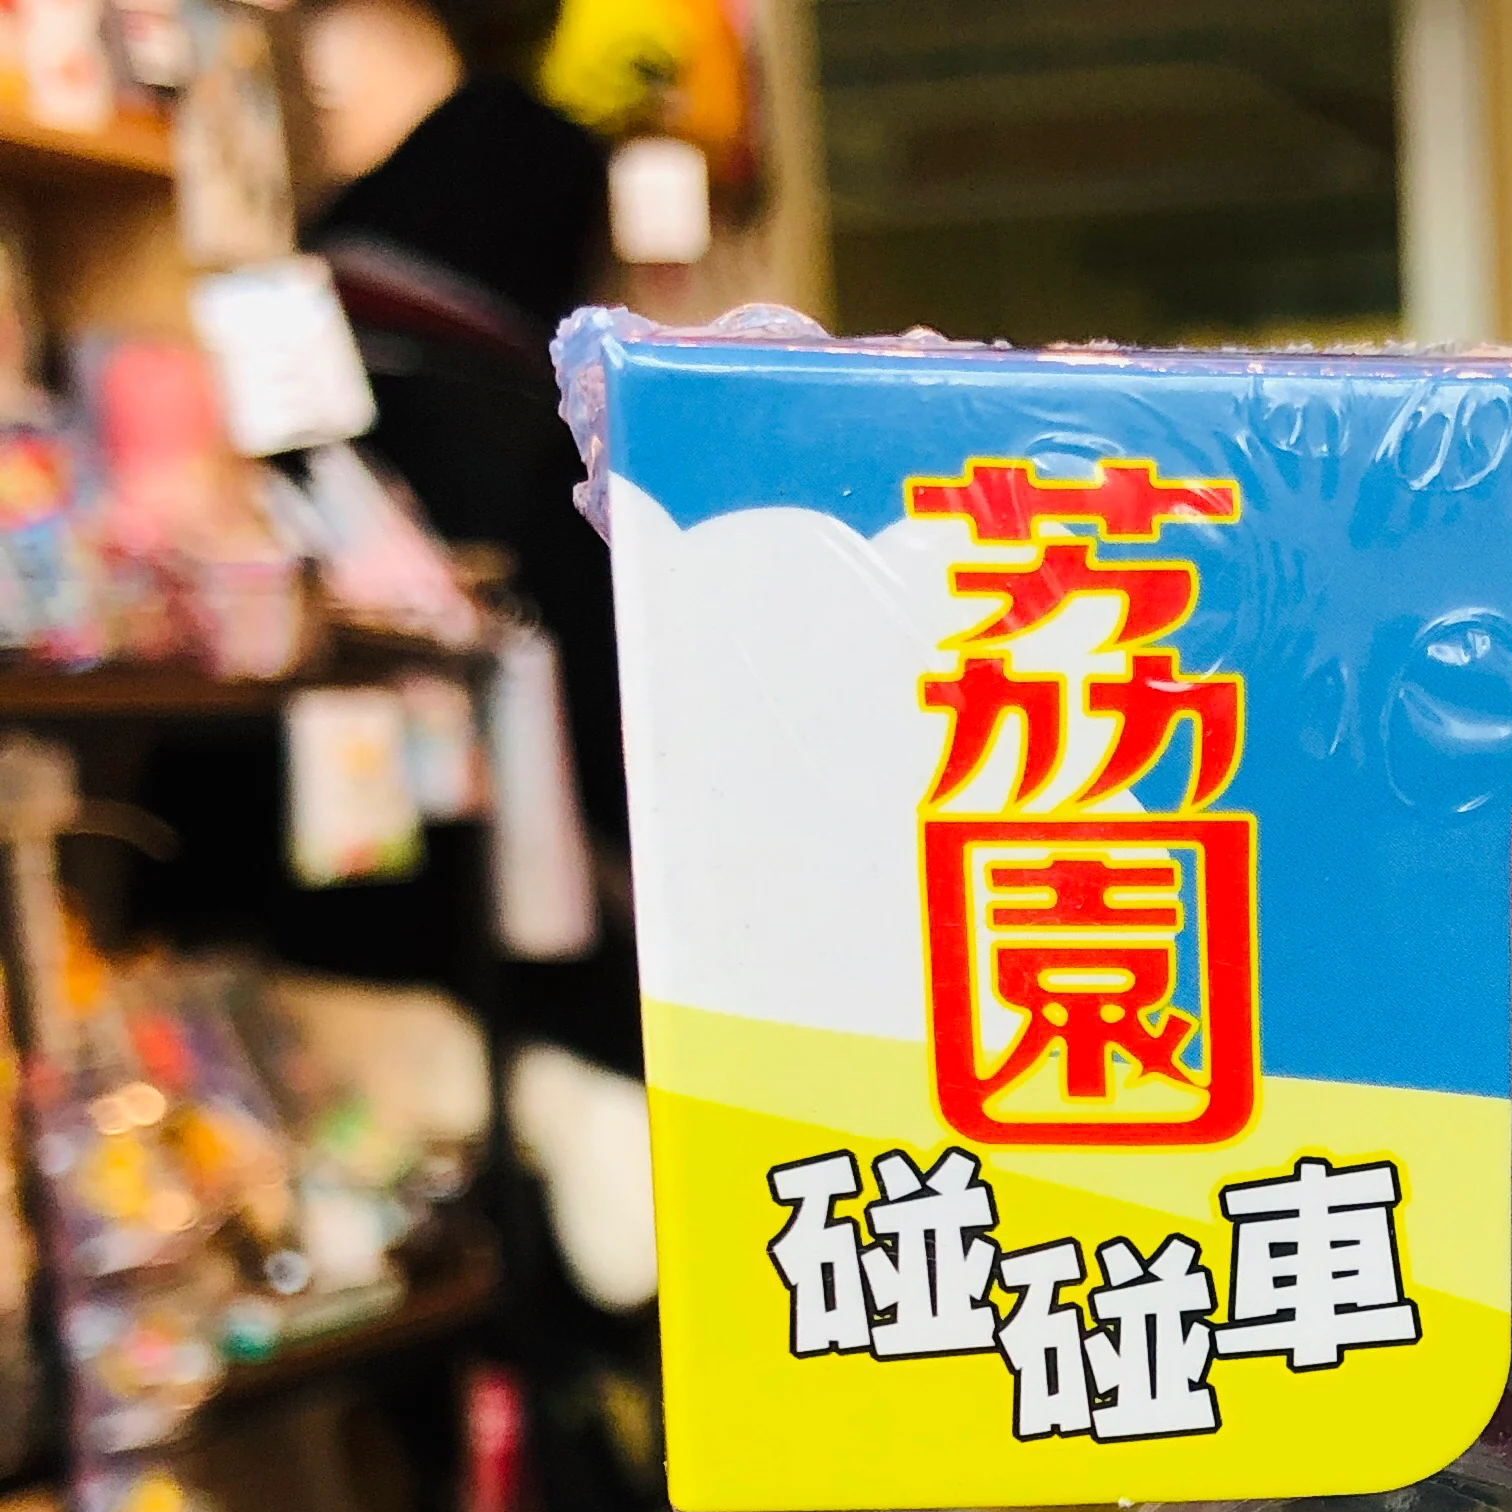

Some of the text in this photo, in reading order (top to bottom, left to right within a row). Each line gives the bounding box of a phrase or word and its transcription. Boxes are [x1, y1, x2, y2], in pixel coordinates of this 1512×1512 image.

[904, 458, 1264, 1154] 荔園
[767, 1146, 1424, 1444] 碰碰車
